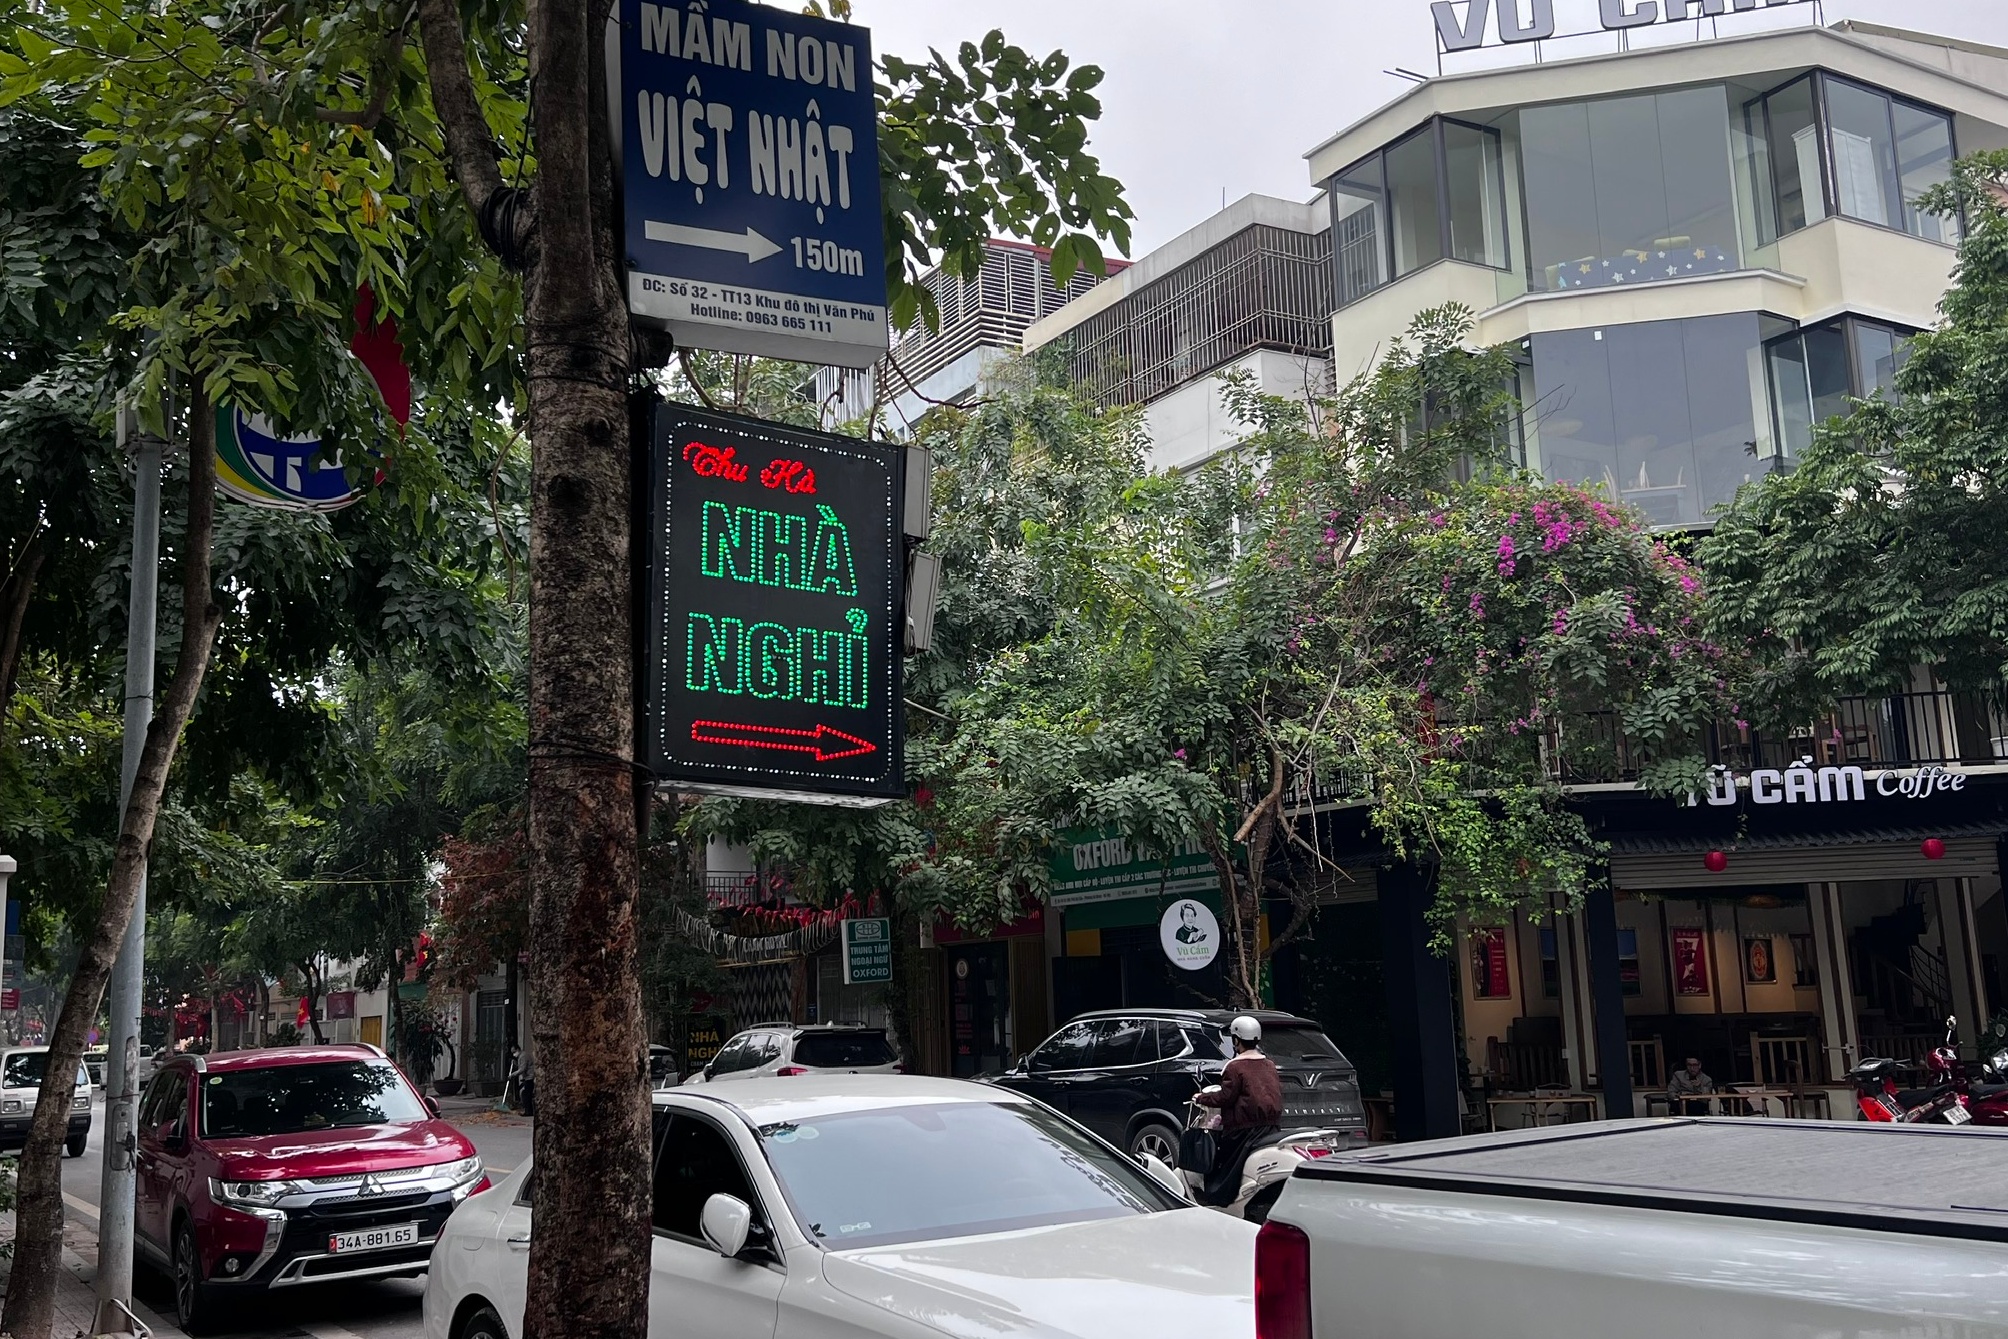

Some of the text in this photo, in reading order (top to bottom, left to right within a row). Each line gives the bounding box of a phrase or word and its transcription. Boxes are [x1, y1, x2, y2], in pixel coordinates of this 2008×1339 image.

[641, 0, 855, 92] MẦM NON
[638, 75, 853, 225] VIỆT NHẬT
[790, 236, 864, 277] 150m
[643, 278, 665, 293] ĐC:
[670, 281, 688, 297] Số
[692, 286, 708, 299] 32
[721, 289, 751, 305] TT13
[755, 294, 781, 310] Khu
[785, 299, 799, 313] đô
[803, 302, 820, 317] thị
[824, 304, 847, 318] Văn
[850, 307, 875, 322] Phú
[691, 303, 832, 333] Hotline: 0963 665 111
[682, 441, 751, 483] Thu
[701, 501, 858, 596] NHÀ
[686, 607, 869, 709] NGHỈ
[1750, 755, 1866, 804] CẨM
[1876, 766, 1967, 799] Coffee
[1073, 837, 1134, 872] OXFORD
[853, 968, 889, 978] OXFORD
[337, 1229, 411, 1250] 34A-881.65
